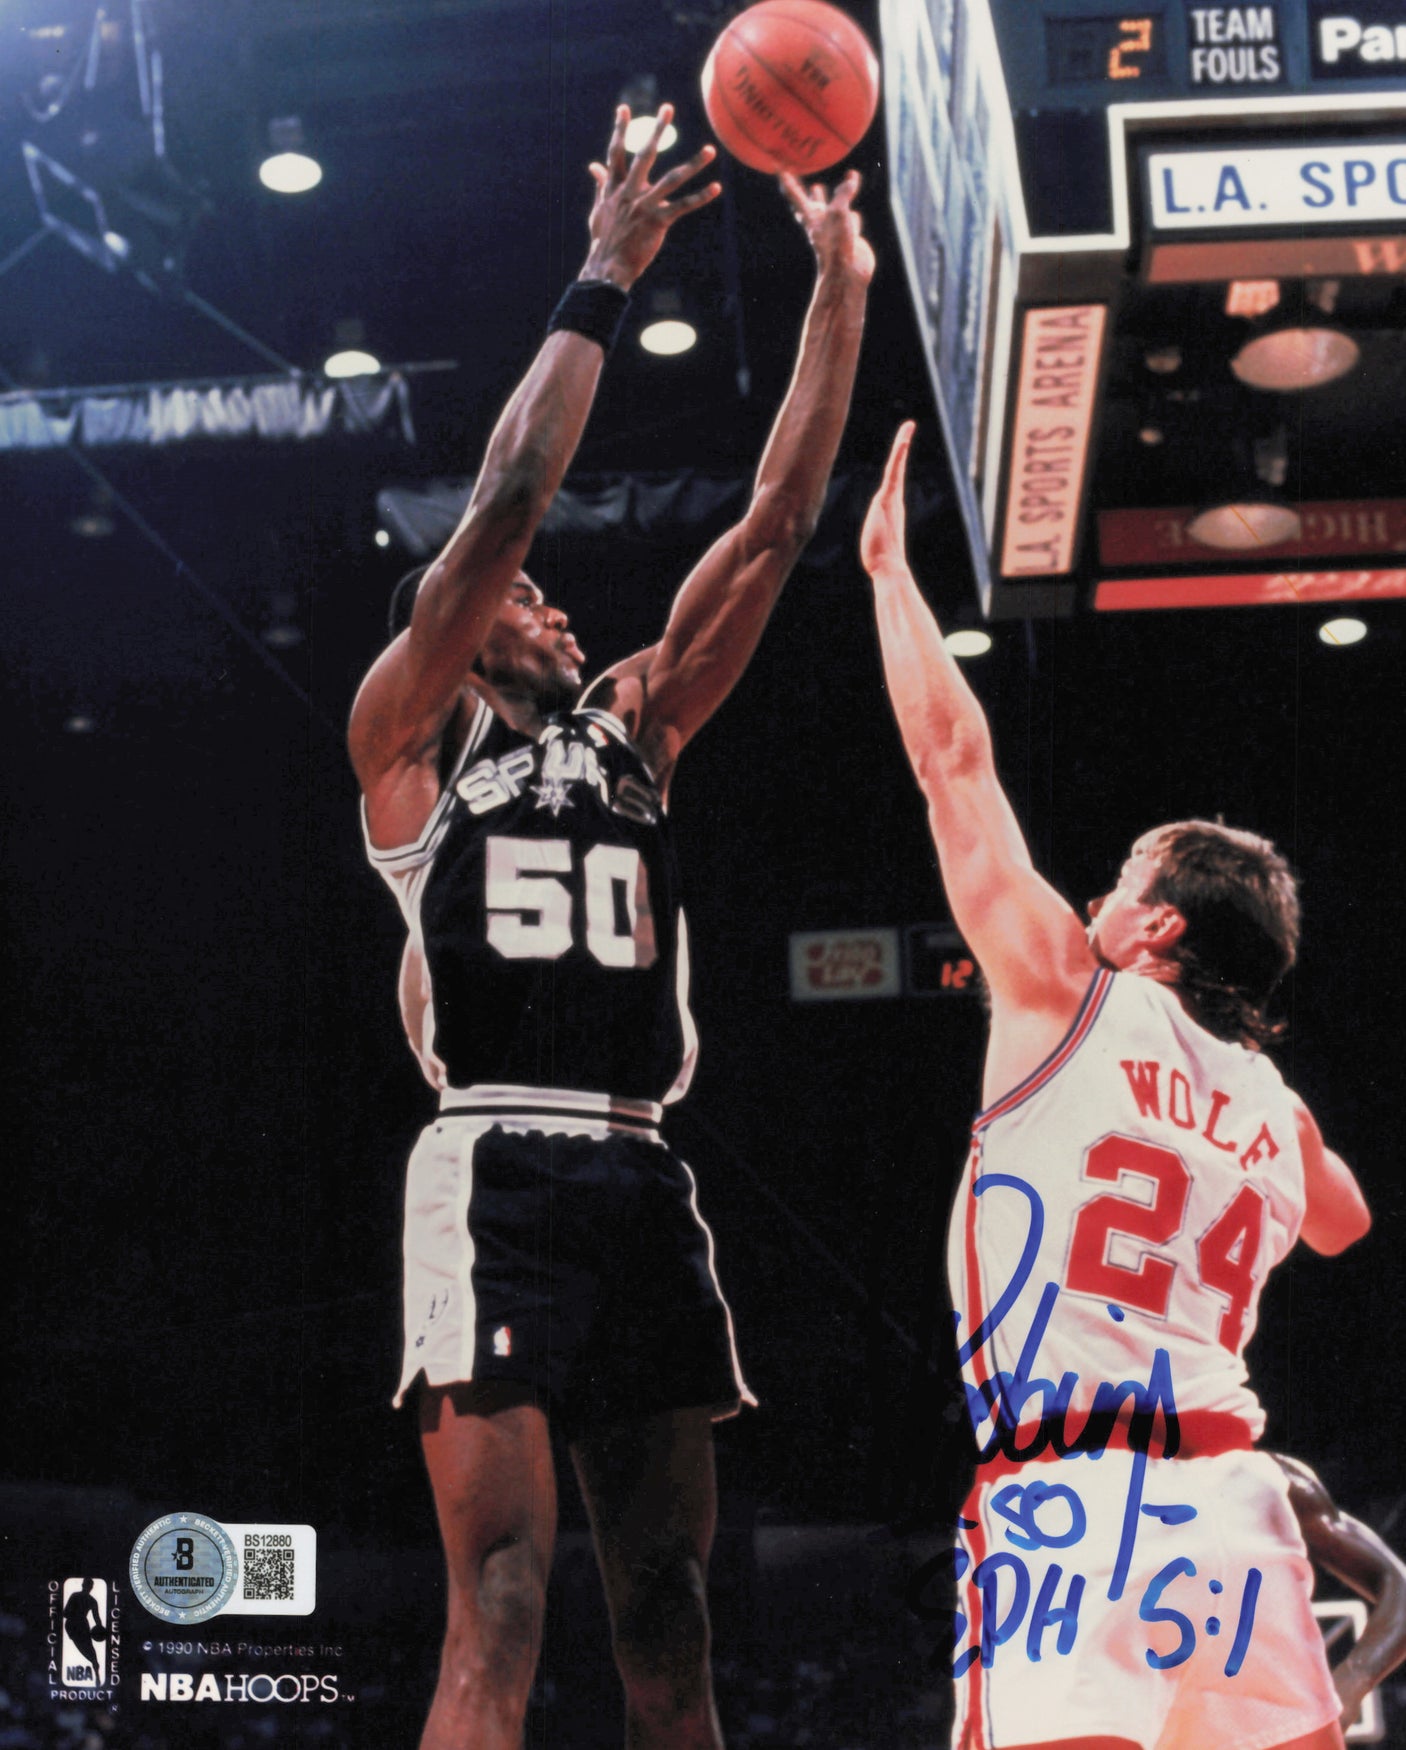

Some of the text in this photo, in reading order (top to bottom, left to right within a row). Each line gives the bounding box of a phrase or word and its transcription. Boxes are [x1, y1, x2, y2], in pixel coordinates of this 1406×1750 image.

[1109, 19, 1152, 78] 2
[1191, 8, 1273, 41] TEAM
[1191, 46, 1280, 81] FOULS
[1162, 165, 1267, 213] L.A.
[1031, 308, 1091, 408] ARENA
[1018, 426, 1075, 524] SPORTS
[486, 836, 657, 969] 50
[941, 959, 973, 989] 12
[1120, 1060, 1280, 1171] WOLF
[1061, 1130, 1269, 1357] 24
[131, 1517, 171, 1617] BECKETT VERIFIED AUTHENTIC
[194, 1518, 233, 1617] BECKETT VERIFIED AUTHENTIC
[244, 1534, 292, 1547] BS12880
[154, 1576, 215, 1587] AUTHENTICATED
